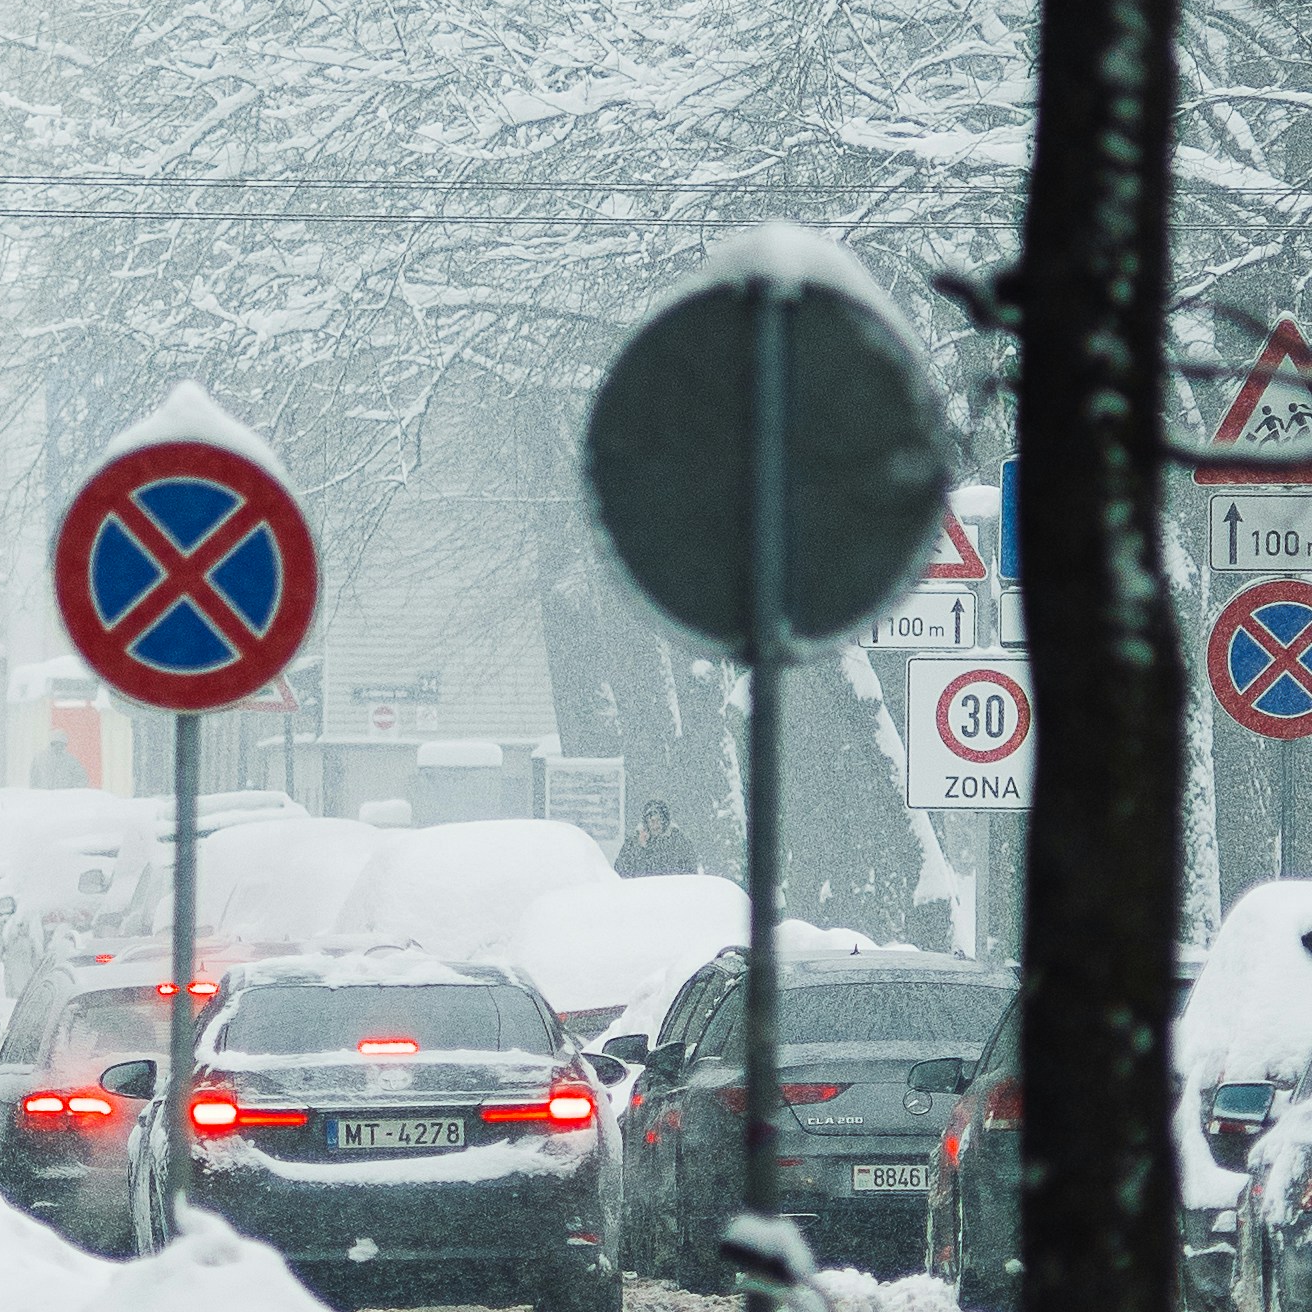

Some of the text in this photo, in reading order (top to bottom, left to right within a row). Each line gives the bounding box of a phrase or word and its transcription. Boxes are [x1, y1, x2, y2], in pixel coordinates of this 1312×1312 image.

[1251, 530, 1299, 557] 100
[886, 617, 945, 638] 100 m
[961, 694, 1005, 739] 30
[944, 776, 1021, 800] ZONA
[807, 1116, 864, 1126] CLA 200
[345, 1122, 460, 1146] MT-4278
